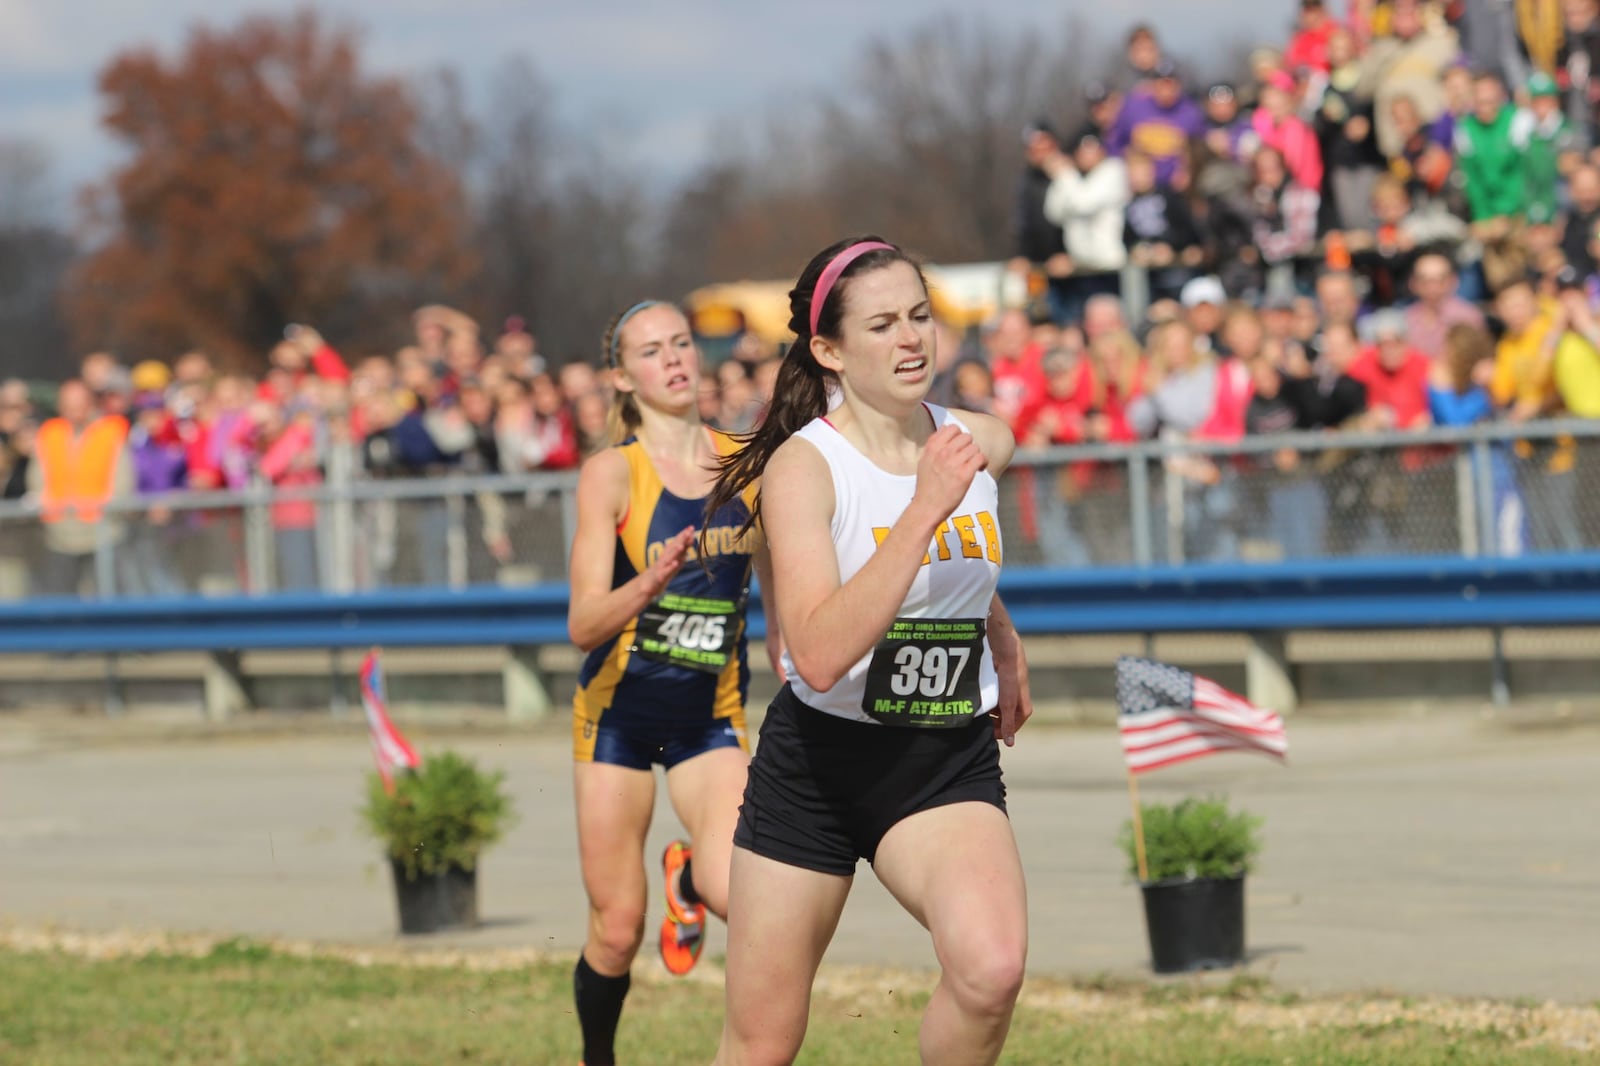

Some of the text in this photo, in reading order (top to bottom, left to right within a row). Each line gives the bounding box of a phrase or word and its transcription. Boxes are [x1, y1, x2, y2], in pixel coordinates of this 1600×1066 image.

[872, 511, 1001, 568] TER
[657, 612, 727, 652] 405
[891, 645, 971, 698] 397
[874, 699, 974, 716] M-F ATHLETIC
